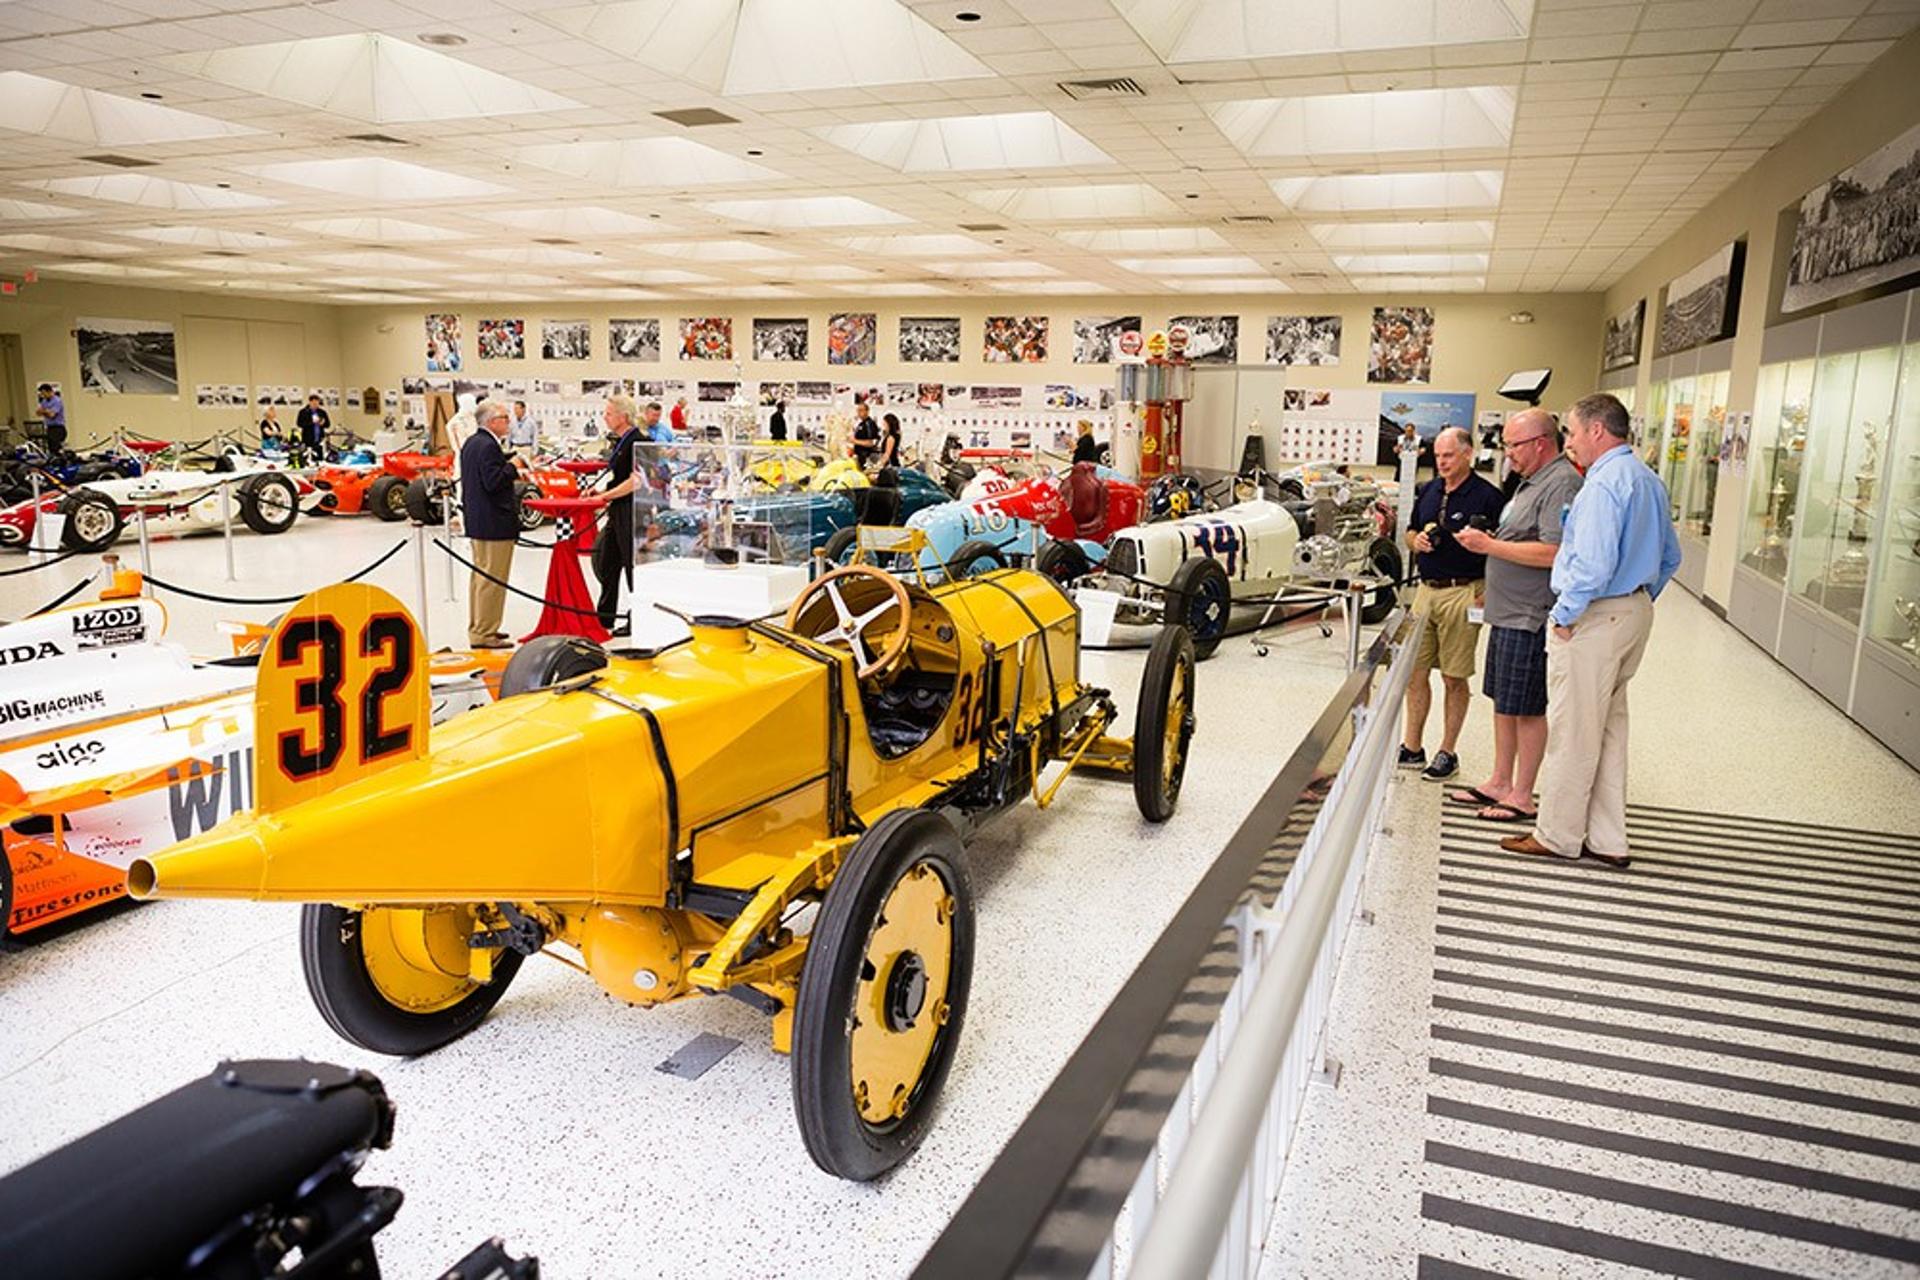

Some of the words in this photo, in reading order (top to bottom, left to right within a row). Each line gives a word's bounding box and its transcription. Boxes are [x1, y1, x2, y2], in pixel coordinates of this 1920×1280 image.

[76, 607, 138, 630] IZOD
[33, 689, 104, 717] MACHINE
[276, 611, 415, 783] 32
[168, 747, 254, 842] WI
[14, 882, 124, 926] Firestone
